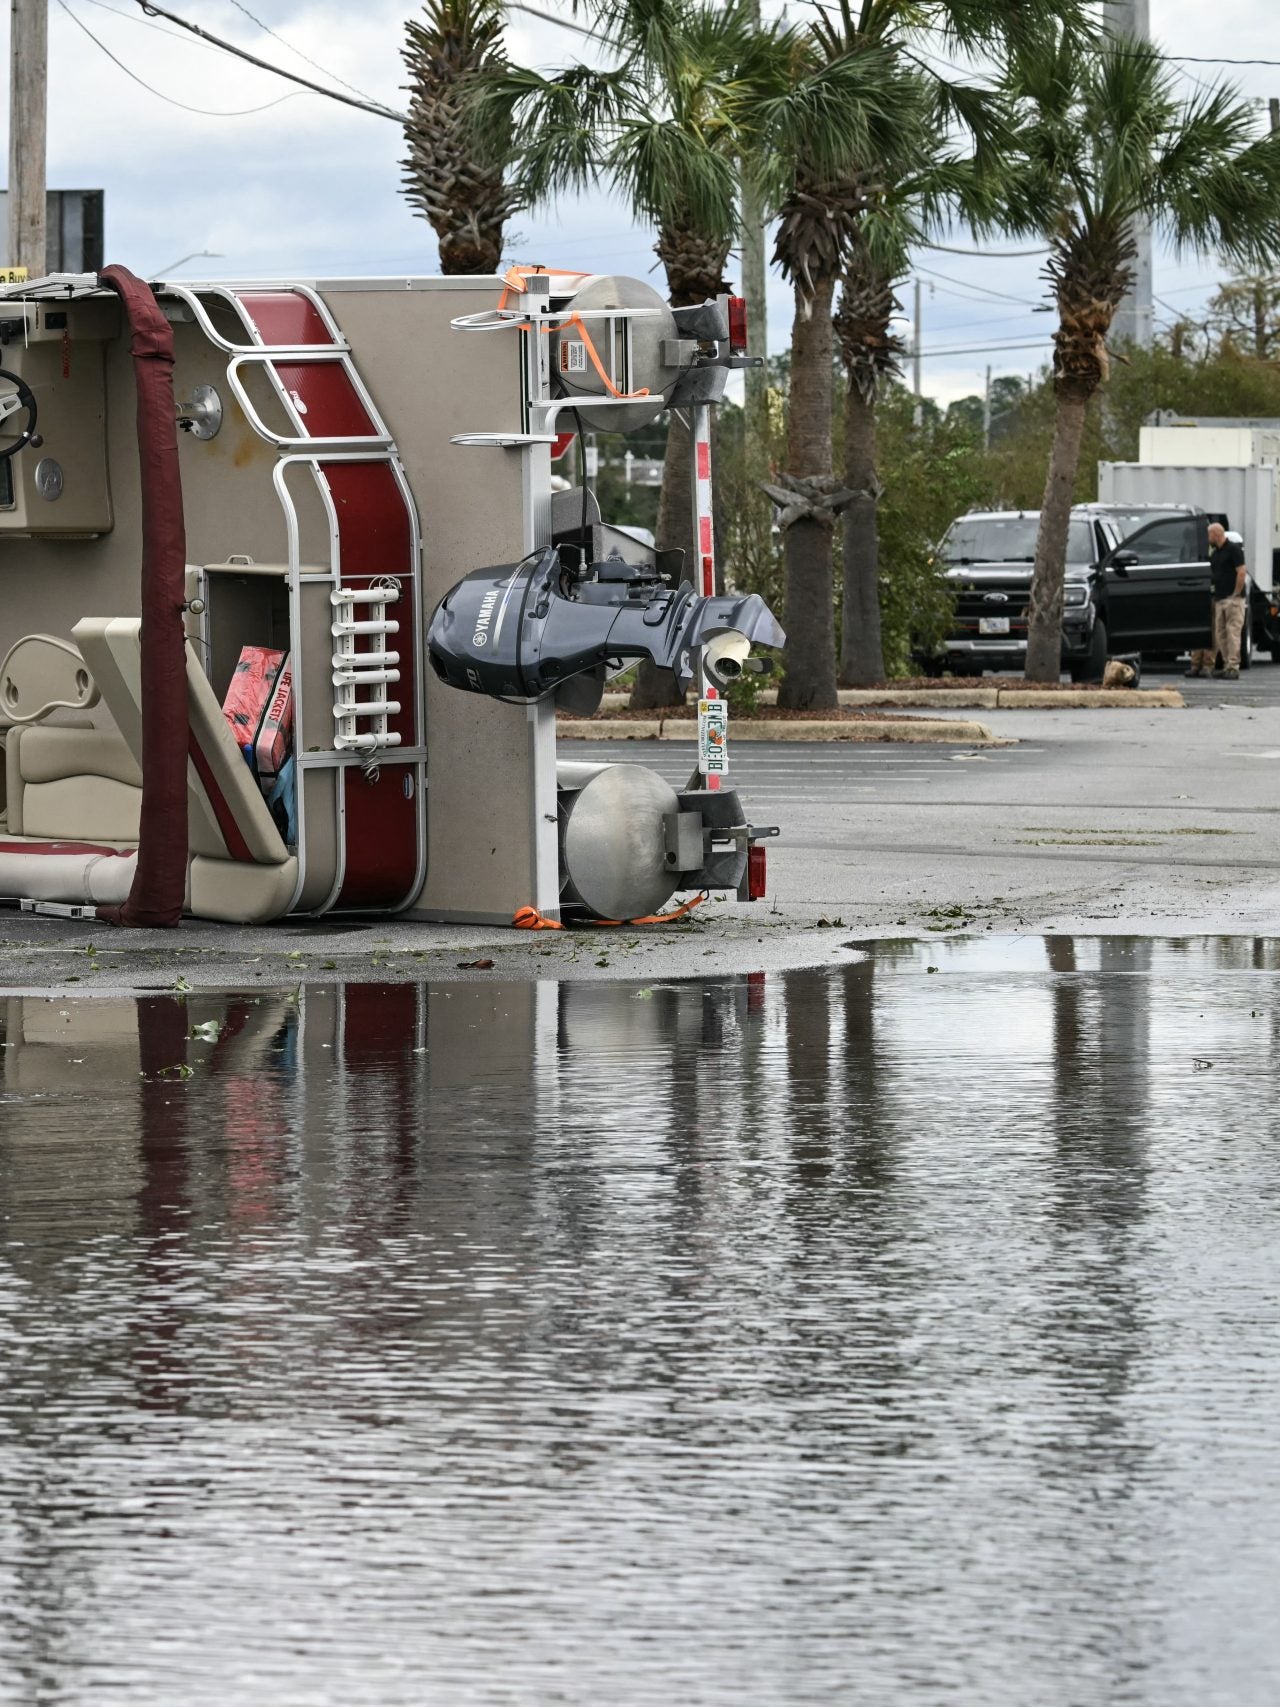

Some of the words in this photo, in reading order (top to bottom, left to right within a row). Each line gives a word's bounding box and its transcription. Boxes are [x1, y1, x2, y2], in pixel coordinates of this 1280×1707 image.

[475, 590, 500, 632] YAMAHA
[281, 672, 292, 687] LIFE
[269, 688, 288, 722] JACKETS
